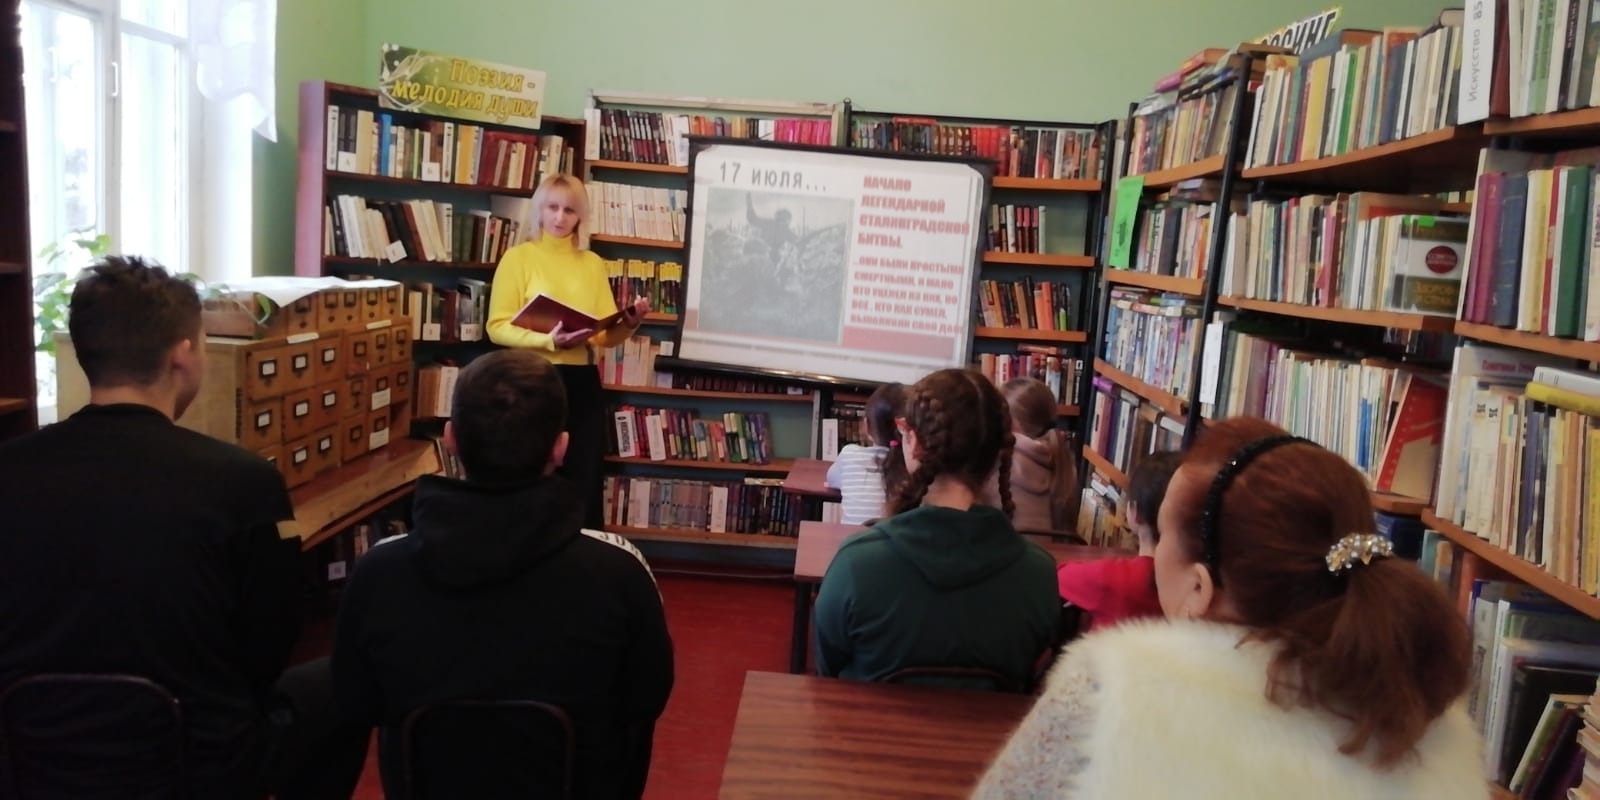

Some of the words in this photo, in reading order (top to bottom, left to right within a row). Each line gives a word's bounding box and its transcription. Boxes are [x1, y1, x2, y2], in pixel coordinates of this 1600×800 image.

[450, 58, 525, 92] Поэзия
[1467, 28, 1482, 102] Искусство
[391, 79, 482, 111] мелодия
[485, 93, 539, 123] души
[720, 161, 741, 184] 17
[863, 175, 912, 192] НАЧАЛО
[861, 195, 946, 214] ЛЕГЕНДАРНОЙ
[859, 214, 971, 236] СТАЛИНГРАДСКОЙ
[879, 257, 909, 269] БЫЛИ
[926, 278, 955, 290] МАЛО
[852, 285, 871, 296] КТО
[944, 294, 959, 305] НО
[874, 301, 893, 312] КТО
[894, 303, 913, 315] КАК
